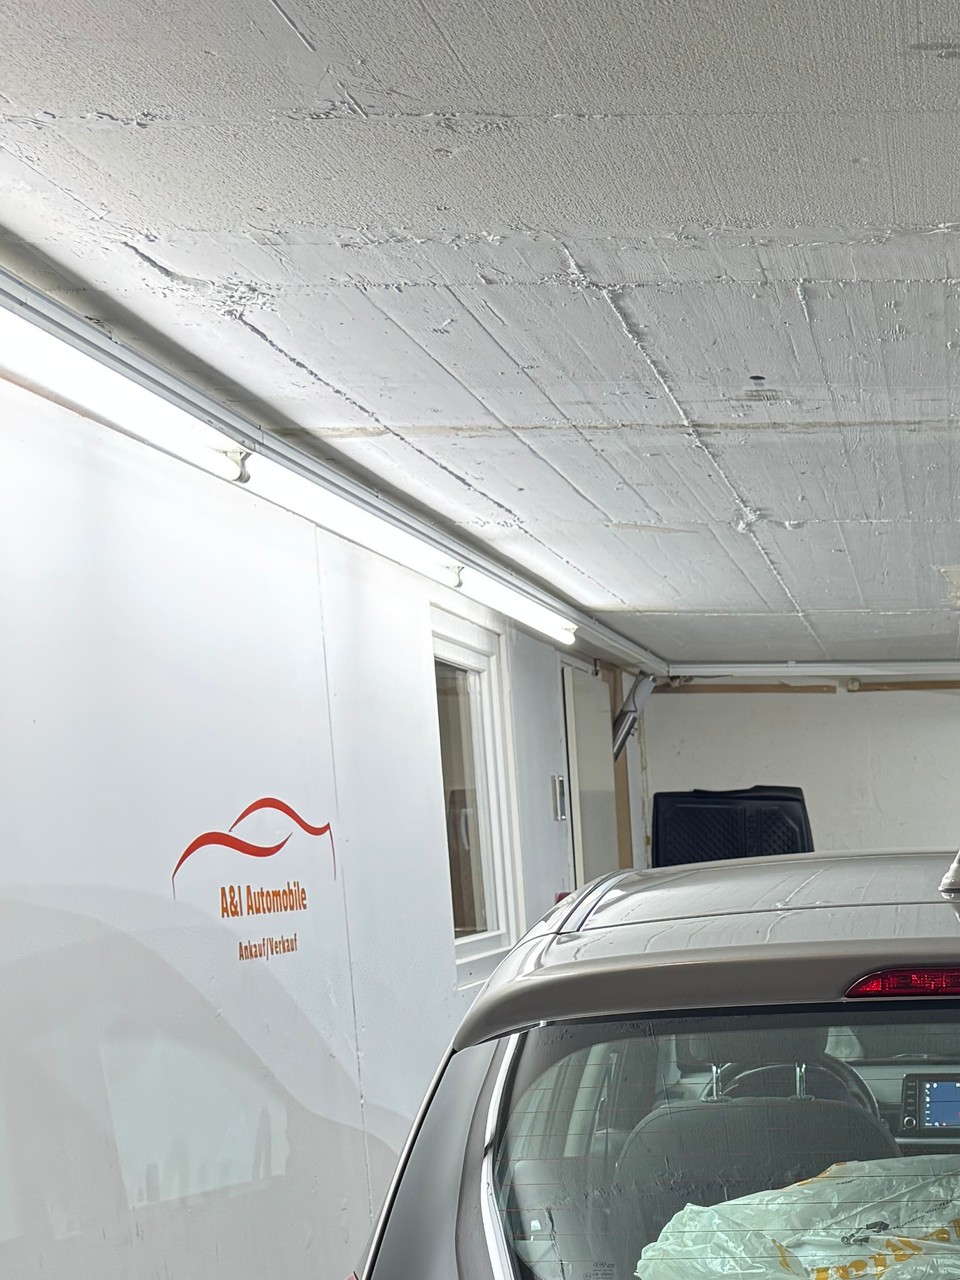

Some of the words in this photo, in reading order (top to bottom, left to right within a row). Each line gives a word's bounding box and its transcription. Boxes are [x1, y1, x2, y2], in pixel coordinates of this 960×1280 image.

[220, 885, 243, 918] A&I
[246, 881, 307, 915] Automobile
[238, 933, 298, 961] Ankauf/Verkauf
